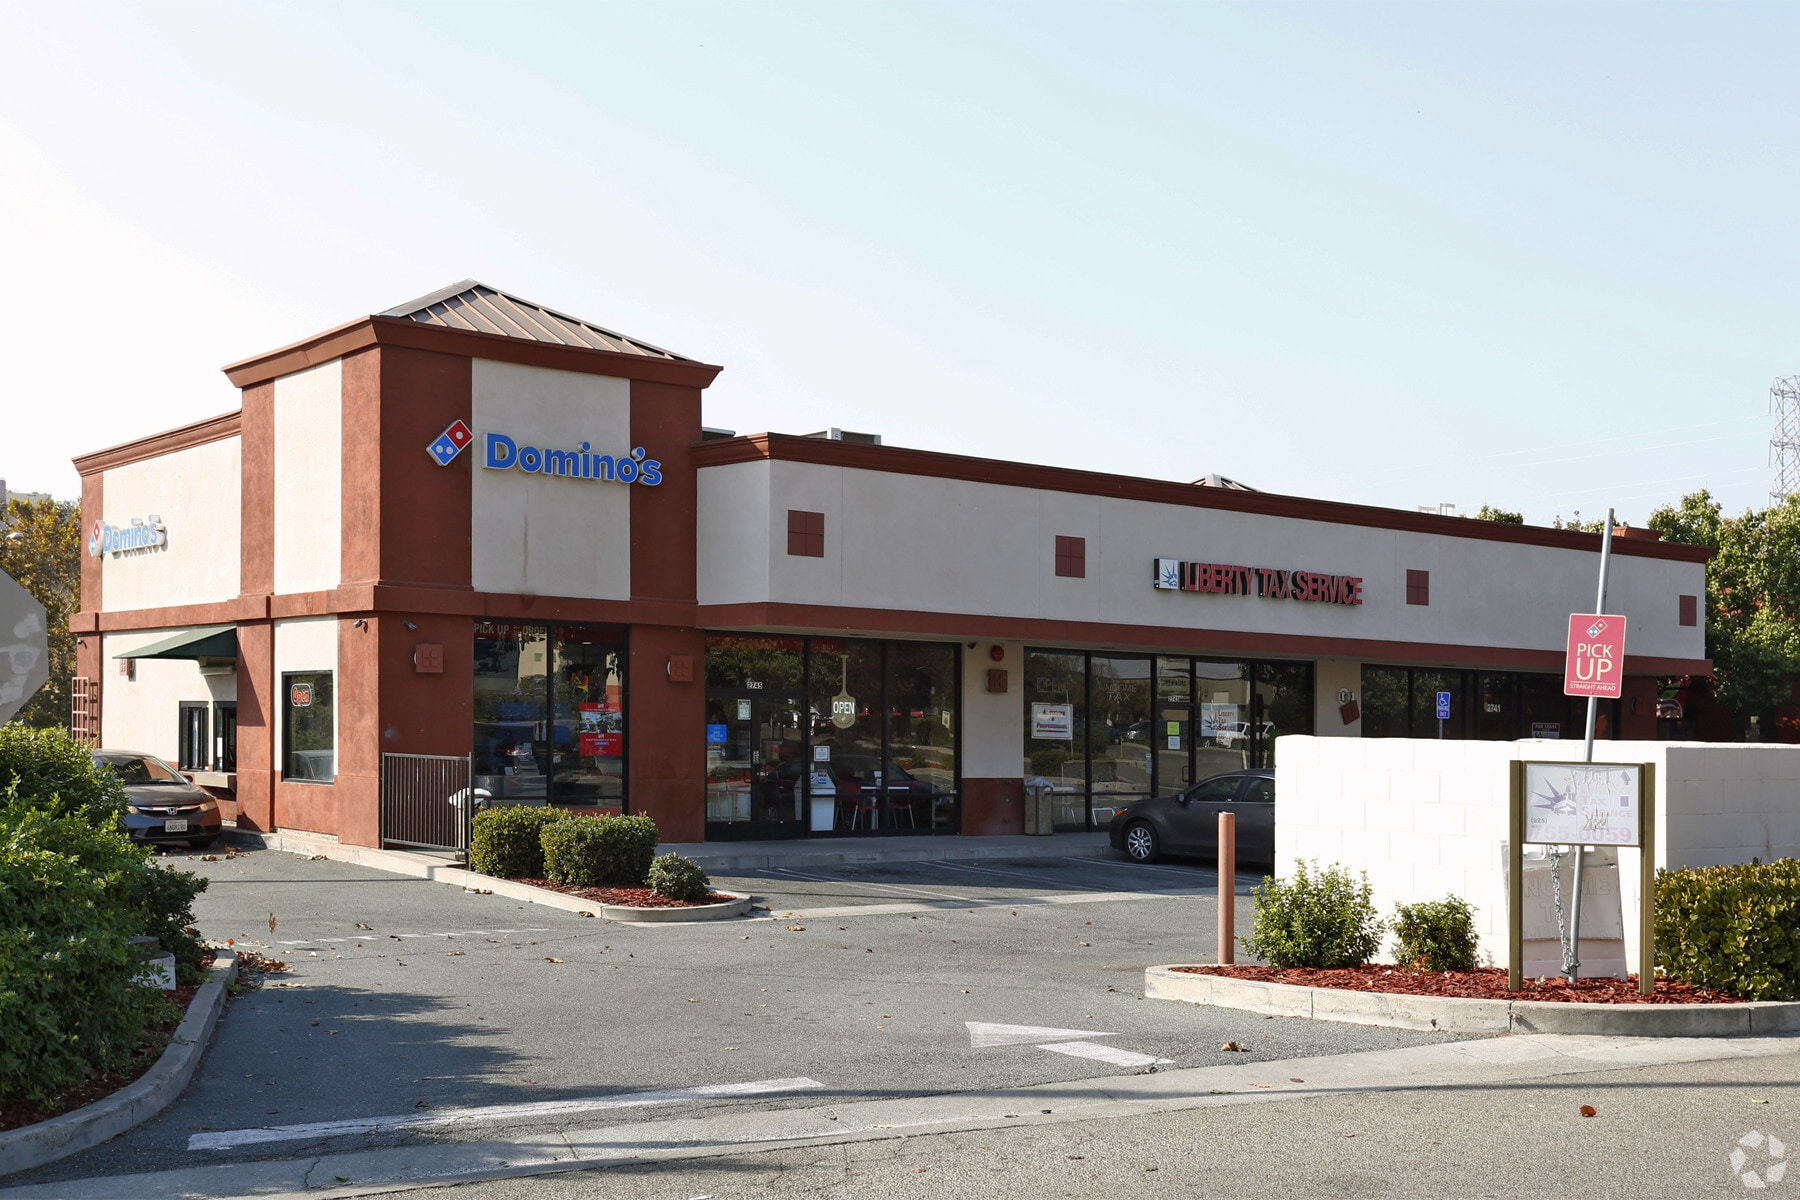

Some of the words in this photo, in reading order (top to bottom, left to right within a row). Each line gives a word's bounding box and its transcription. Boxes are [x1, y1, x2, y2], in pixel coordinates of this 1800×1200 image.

[484, 431, 663, 487] Domino's
[103, 514, 159, 553] Domino's
[1183, 561, 1256, 596] LIBERTY
[1259, 568, 1292, 599] TAX
[1295, 570, 1363, 605] SERVICE
[474, 623, 495, 634] PICK
[497, 624, 510, 635] UP
[1577, 643, 1613, 658] PICK
[1576, 657, 1612, 681] UP
[833, 701, 855, 715] OPEN
[1486, 704, 1501, 712] 2741
